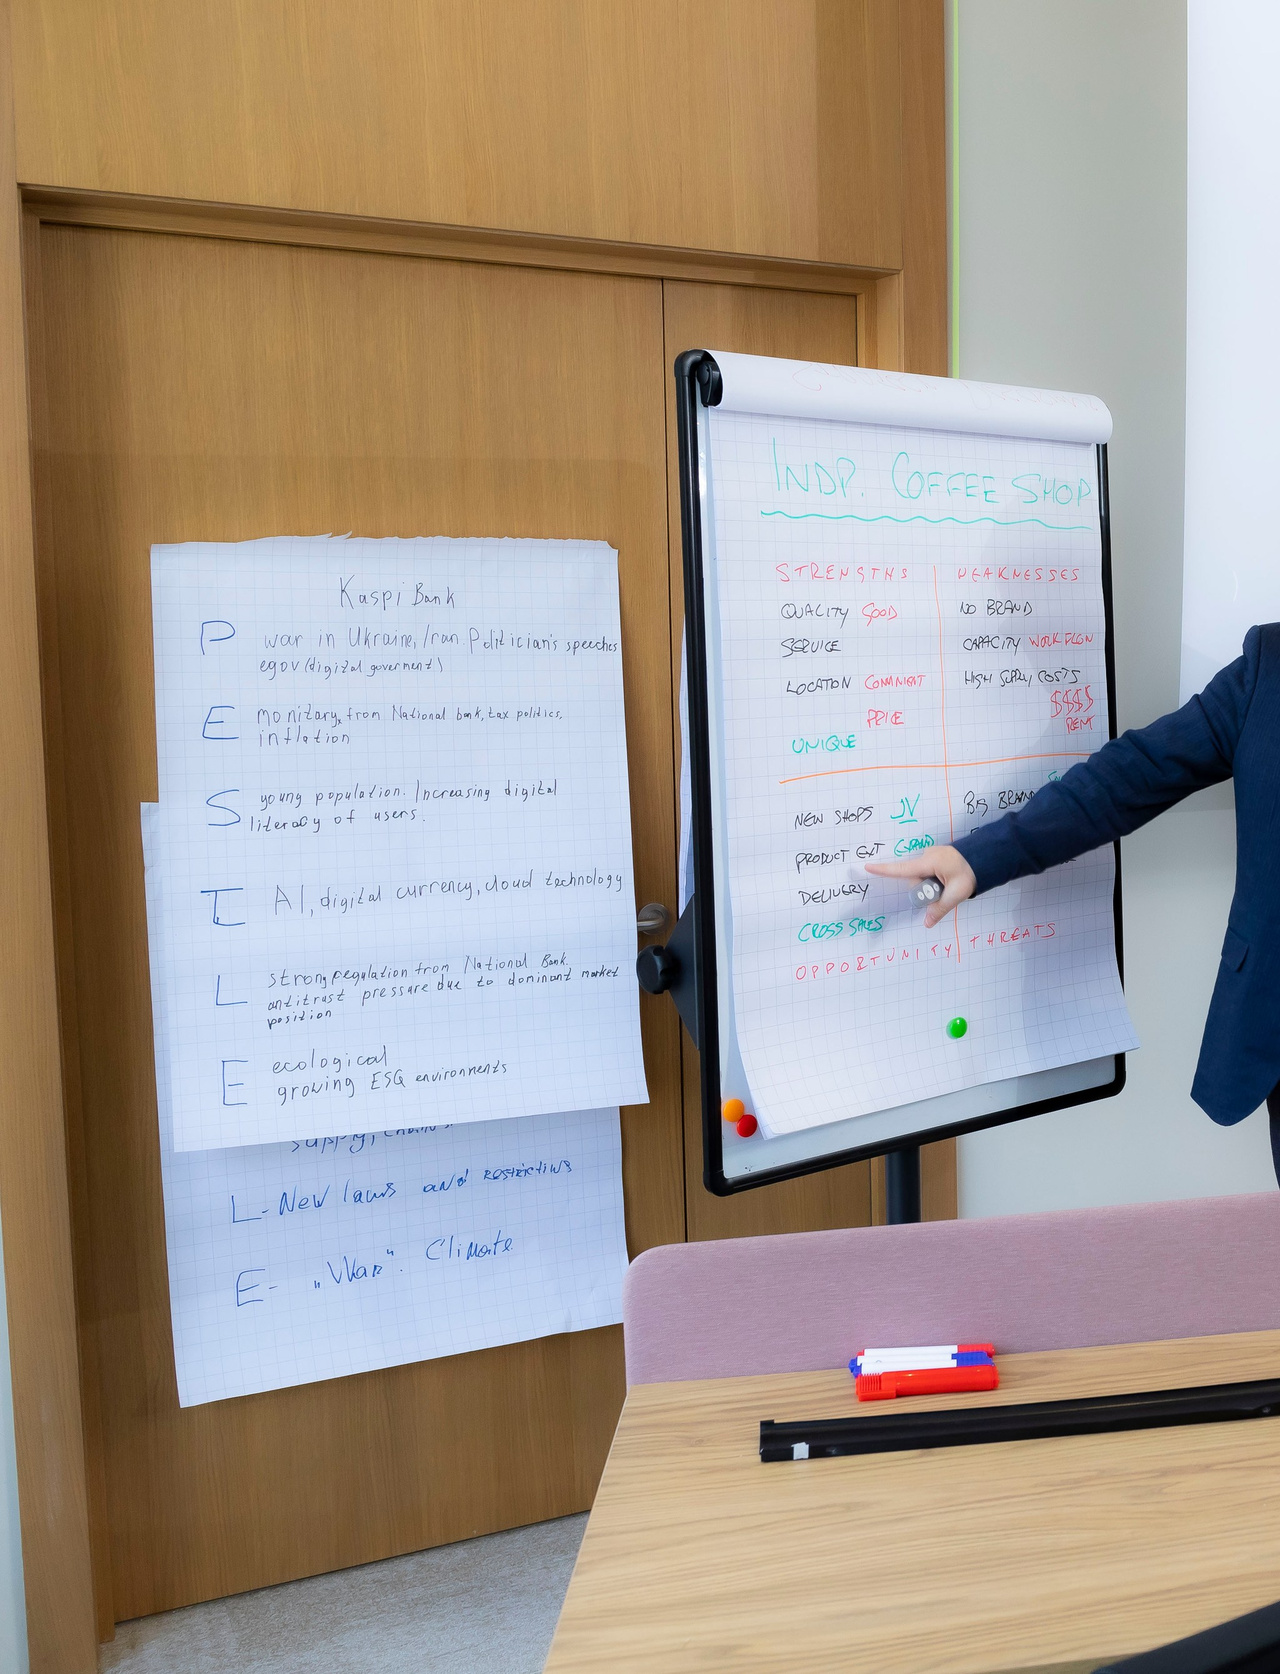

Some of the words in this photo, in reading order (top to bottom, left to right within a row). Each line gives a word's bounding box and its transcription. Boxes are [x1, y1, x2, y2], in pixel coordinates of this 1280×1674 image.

[892, 452, 1000, 504] COFFEE
[1011, 473, 1092, 507] SHOP
[775, 561, 908, 583] STRENGTHS
[340, 574, 405, 611] Kaspi
[411, 582, 455, 609] Bank
[780, 602, 849, 629] QUALITY
[861, 602, 898, 627] GOOD
[959, 601, 977, 615] NO
[986, 598, 1033, 617] BRAND
[200, 620, 236, 655] P
[264, 633, 304, 649] war
[318, 629, 335, 648] in
[566, 635, 618, 656] speeches
[962, 634, 1021, 656] CAPACITY
[964, 670, 993, 689] HIGH
[1037, 667, 1081, 685] COSTS
[202, 705, 240, 740] E
[346, 707, 380, 721] from
[392, 704, 445, 721] National
[488, 706, 509, 720] tax
[259, 725, 351, 747] inflation
[792, 734, 857, 754] UNIQUE
[206, 788, 241, 827] S
[260, 792, 302, 812] young
[415, 778, 490, 803] Increasing
[504, 778, 557, 803] digital
[794, 811, 824, 830] NEW
[834, 805, 874, 825] SHOPS
[889, 793, 921, 819] JV
[250, 815, 321, 834] literacy
[334, 809, 355, 824] of
[795, 849, 850, 875] PRODUCT
[855, 842, 886, 859] EXT
[320, 885, 382, 914] digital
[485, 868, 534, 892] cloud
[545, 867, 623, 893] technology
[798, 883, 870, 906] DELIVERY
[797, 921, 844, 942] CROSS
[849, 916, 886, 938] SALES
[969, 922, 1057, 949] THREATS
[476, 974, 494, 987] to
[508, 967, 572, 987] dominant
[581, 965, 619, 979] market
[795, 944, 952, 981] OPPORTUNITY
[215, 974, 249, 1006] L
[414, 962, 450, 976] from
[464, 952, 528, 975] National
[267, 1009, 332, 1030] position
[221, 1059, 249, 1107] E
[272, 1044, 388, 1075] ecological
[277, 1075, 355, 1107] growing
[279, 1183, 331, 1216] New
